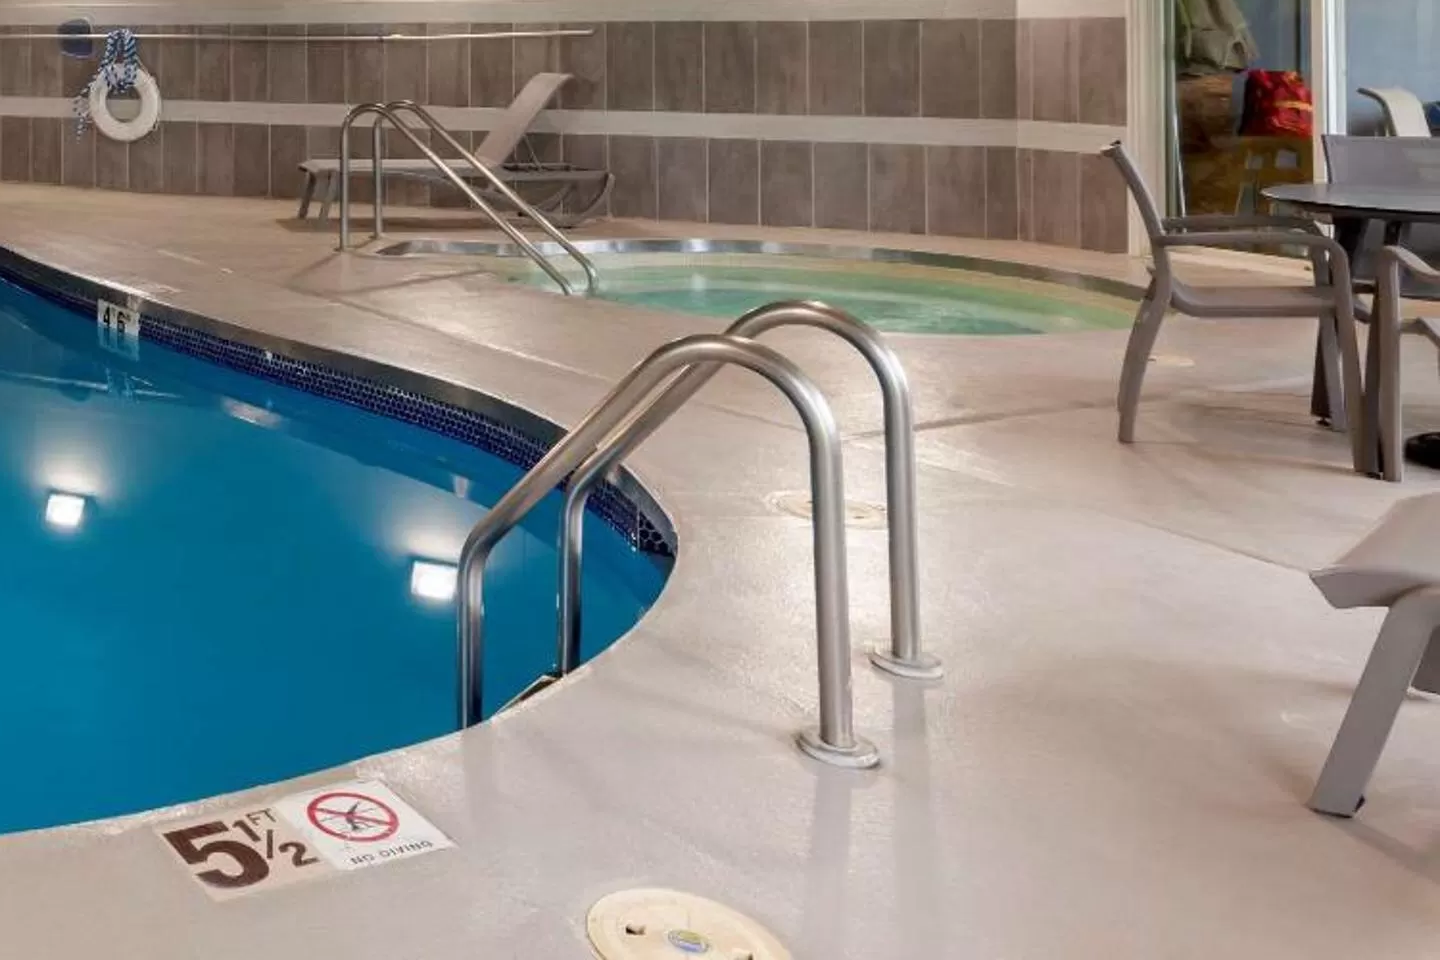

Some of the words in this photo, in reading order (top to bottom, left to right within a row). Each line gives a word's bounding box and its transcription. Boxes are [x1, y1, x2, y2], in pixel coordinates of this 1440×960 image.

[245, 808, 277, 827] FT
[350, 854, 375, 864] NO
[380, 840, 433, 857] DIVING
